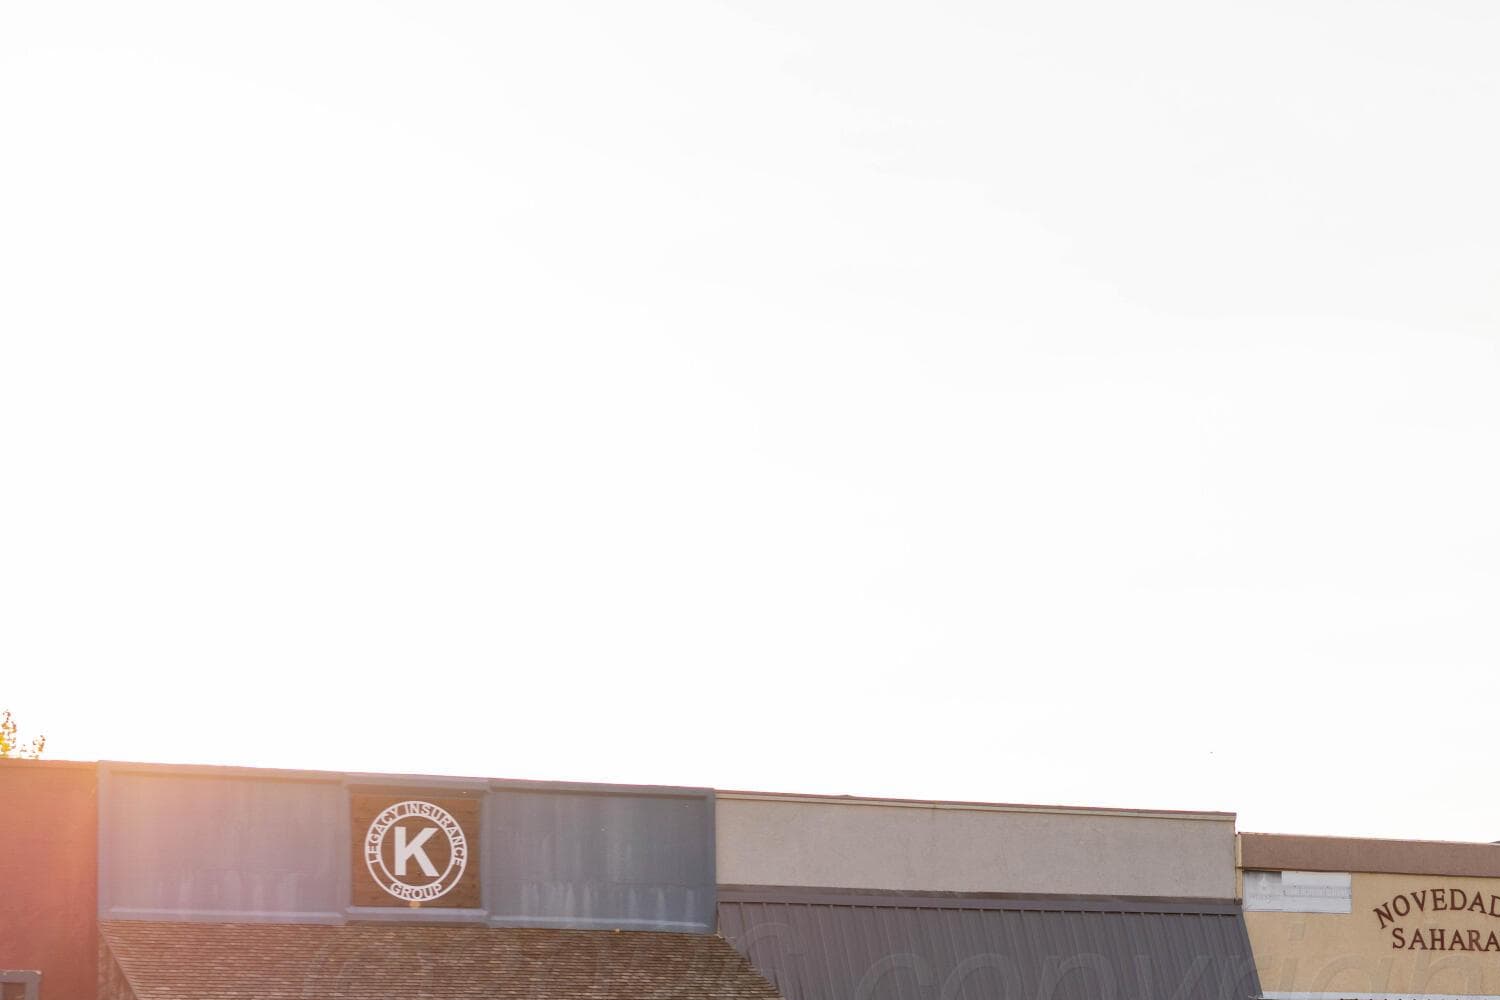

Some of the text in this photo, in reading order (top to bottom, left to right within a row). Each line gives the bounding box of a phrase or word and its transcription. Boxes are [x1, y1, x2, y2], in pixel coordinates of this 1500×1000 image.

[367, 803, 466, 866] LEGACY INSURANCE
[395, 826, 440, 877] K
[389, 882, 442, 900] GROUP
